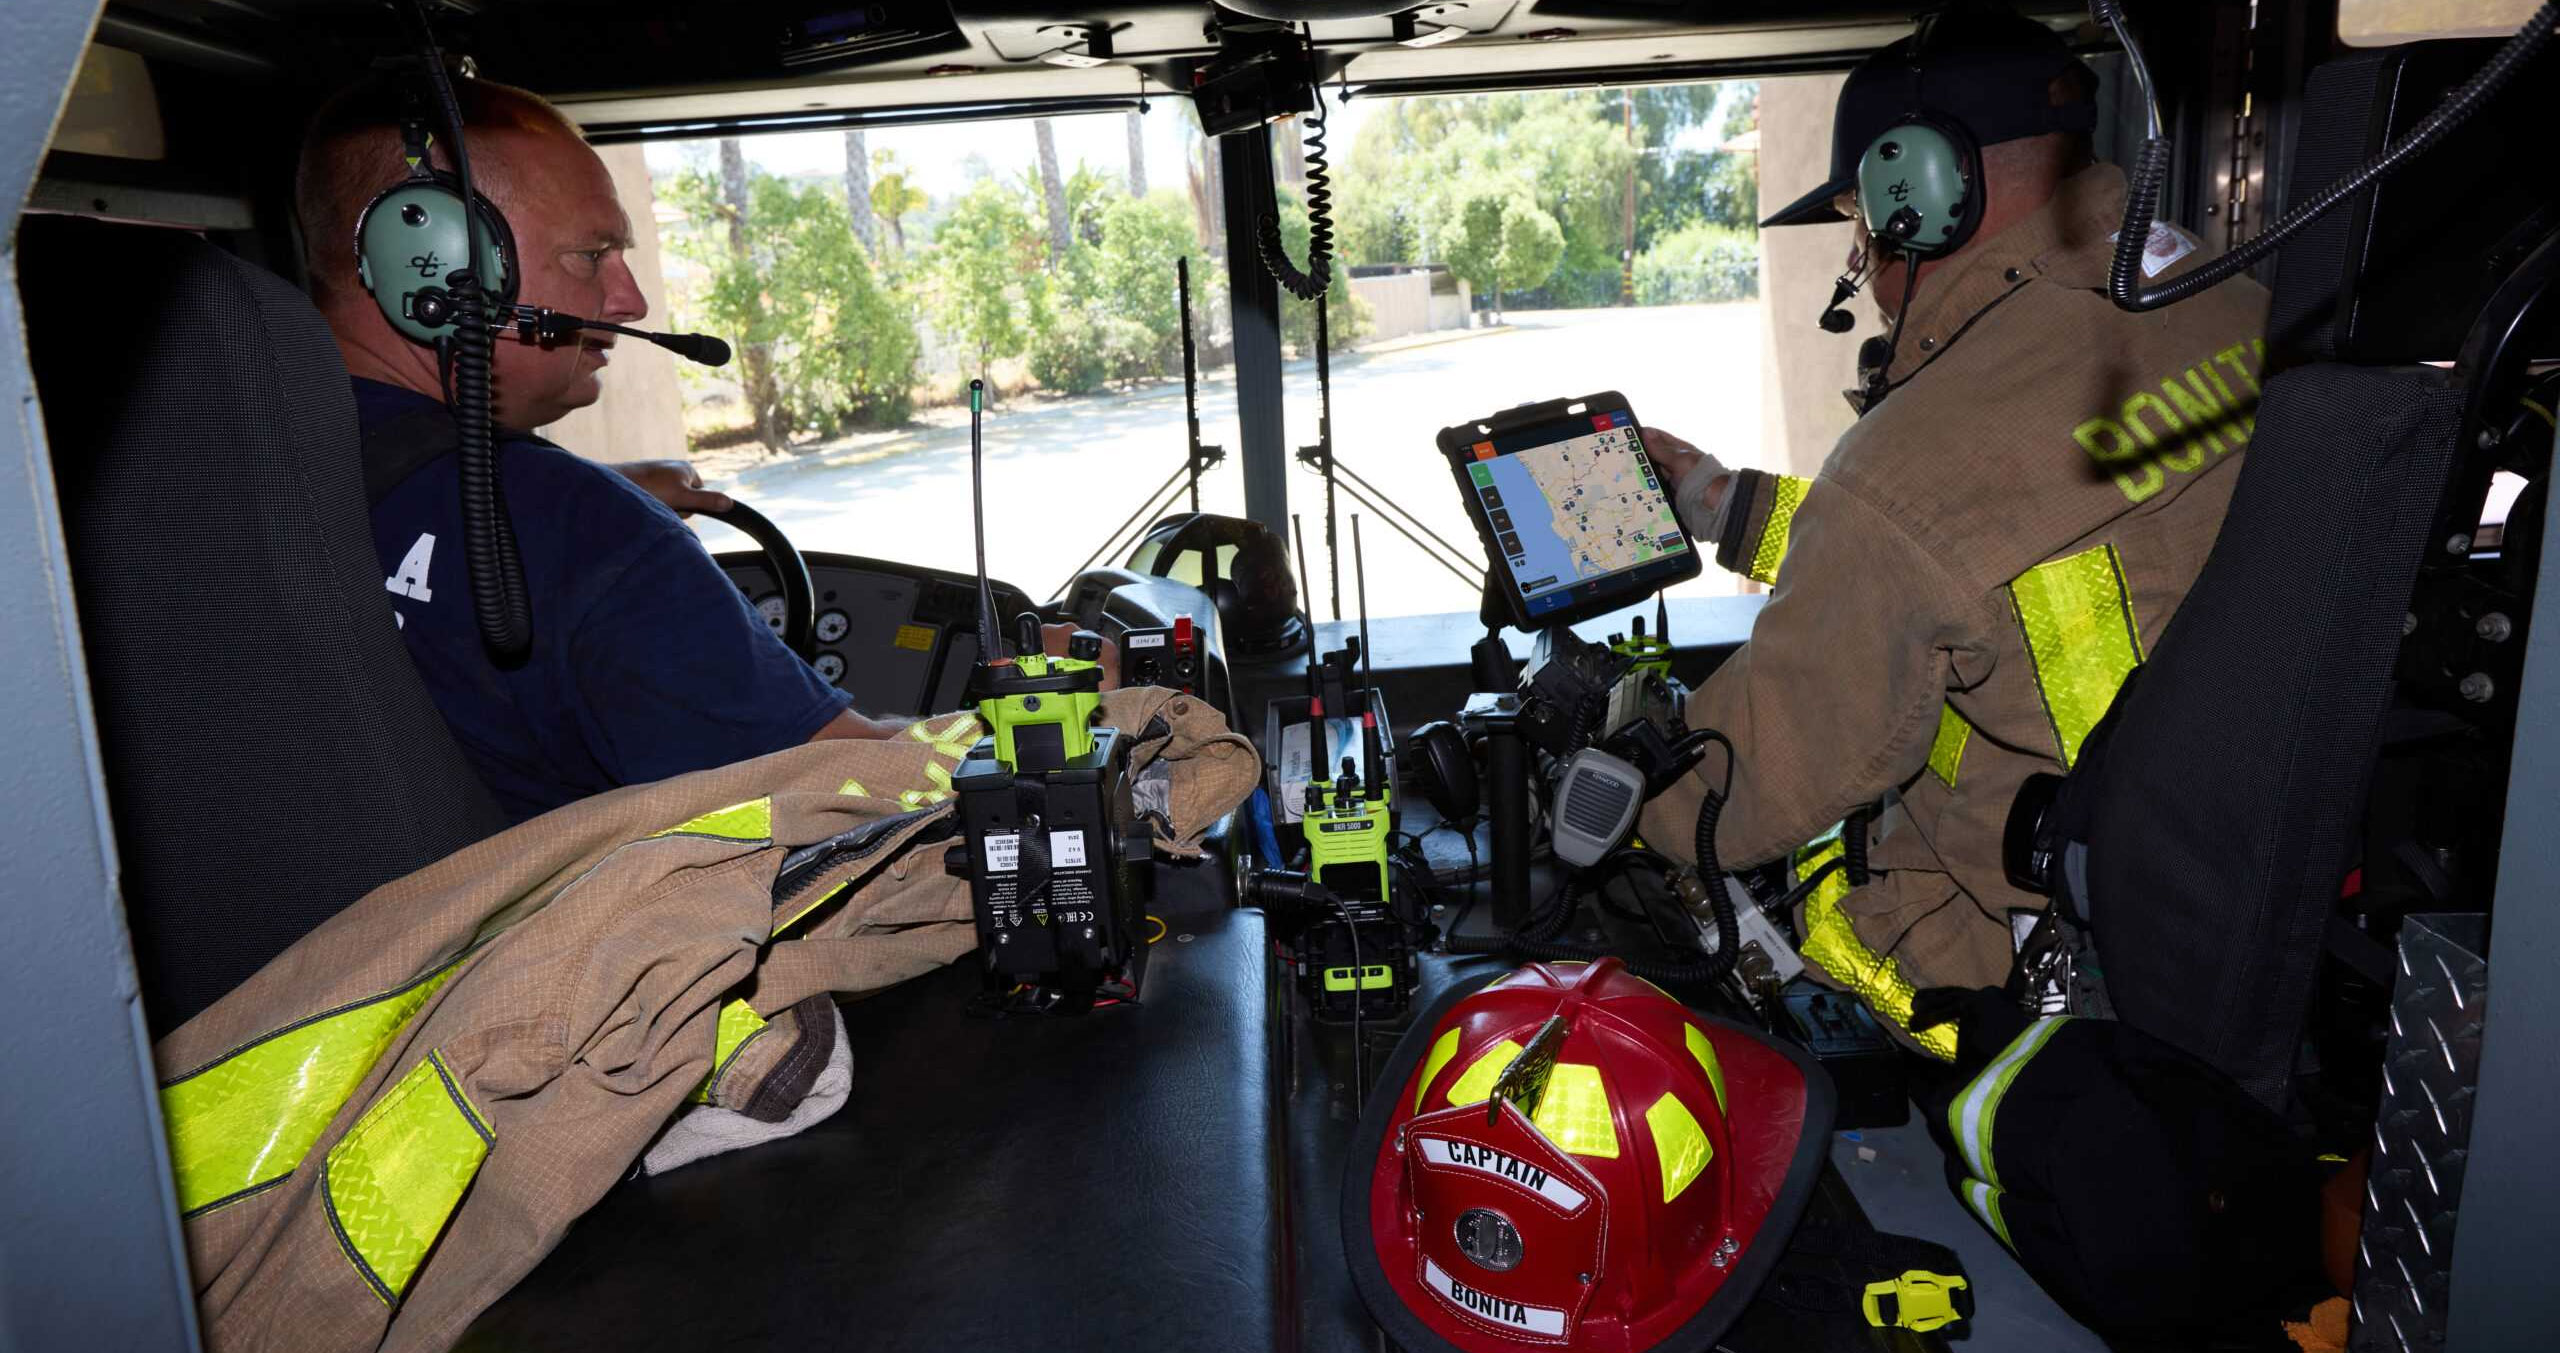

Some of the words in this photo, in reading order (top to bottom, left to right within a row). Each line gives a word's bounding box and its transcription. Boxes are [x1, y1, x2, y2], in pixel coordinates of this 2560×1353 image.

[2072, 338, 2262, 503] BONIT
[1447, 1140, 1548, 1192] CAPTAIN
[1450, 1279, 1528, 1326] BONITA
